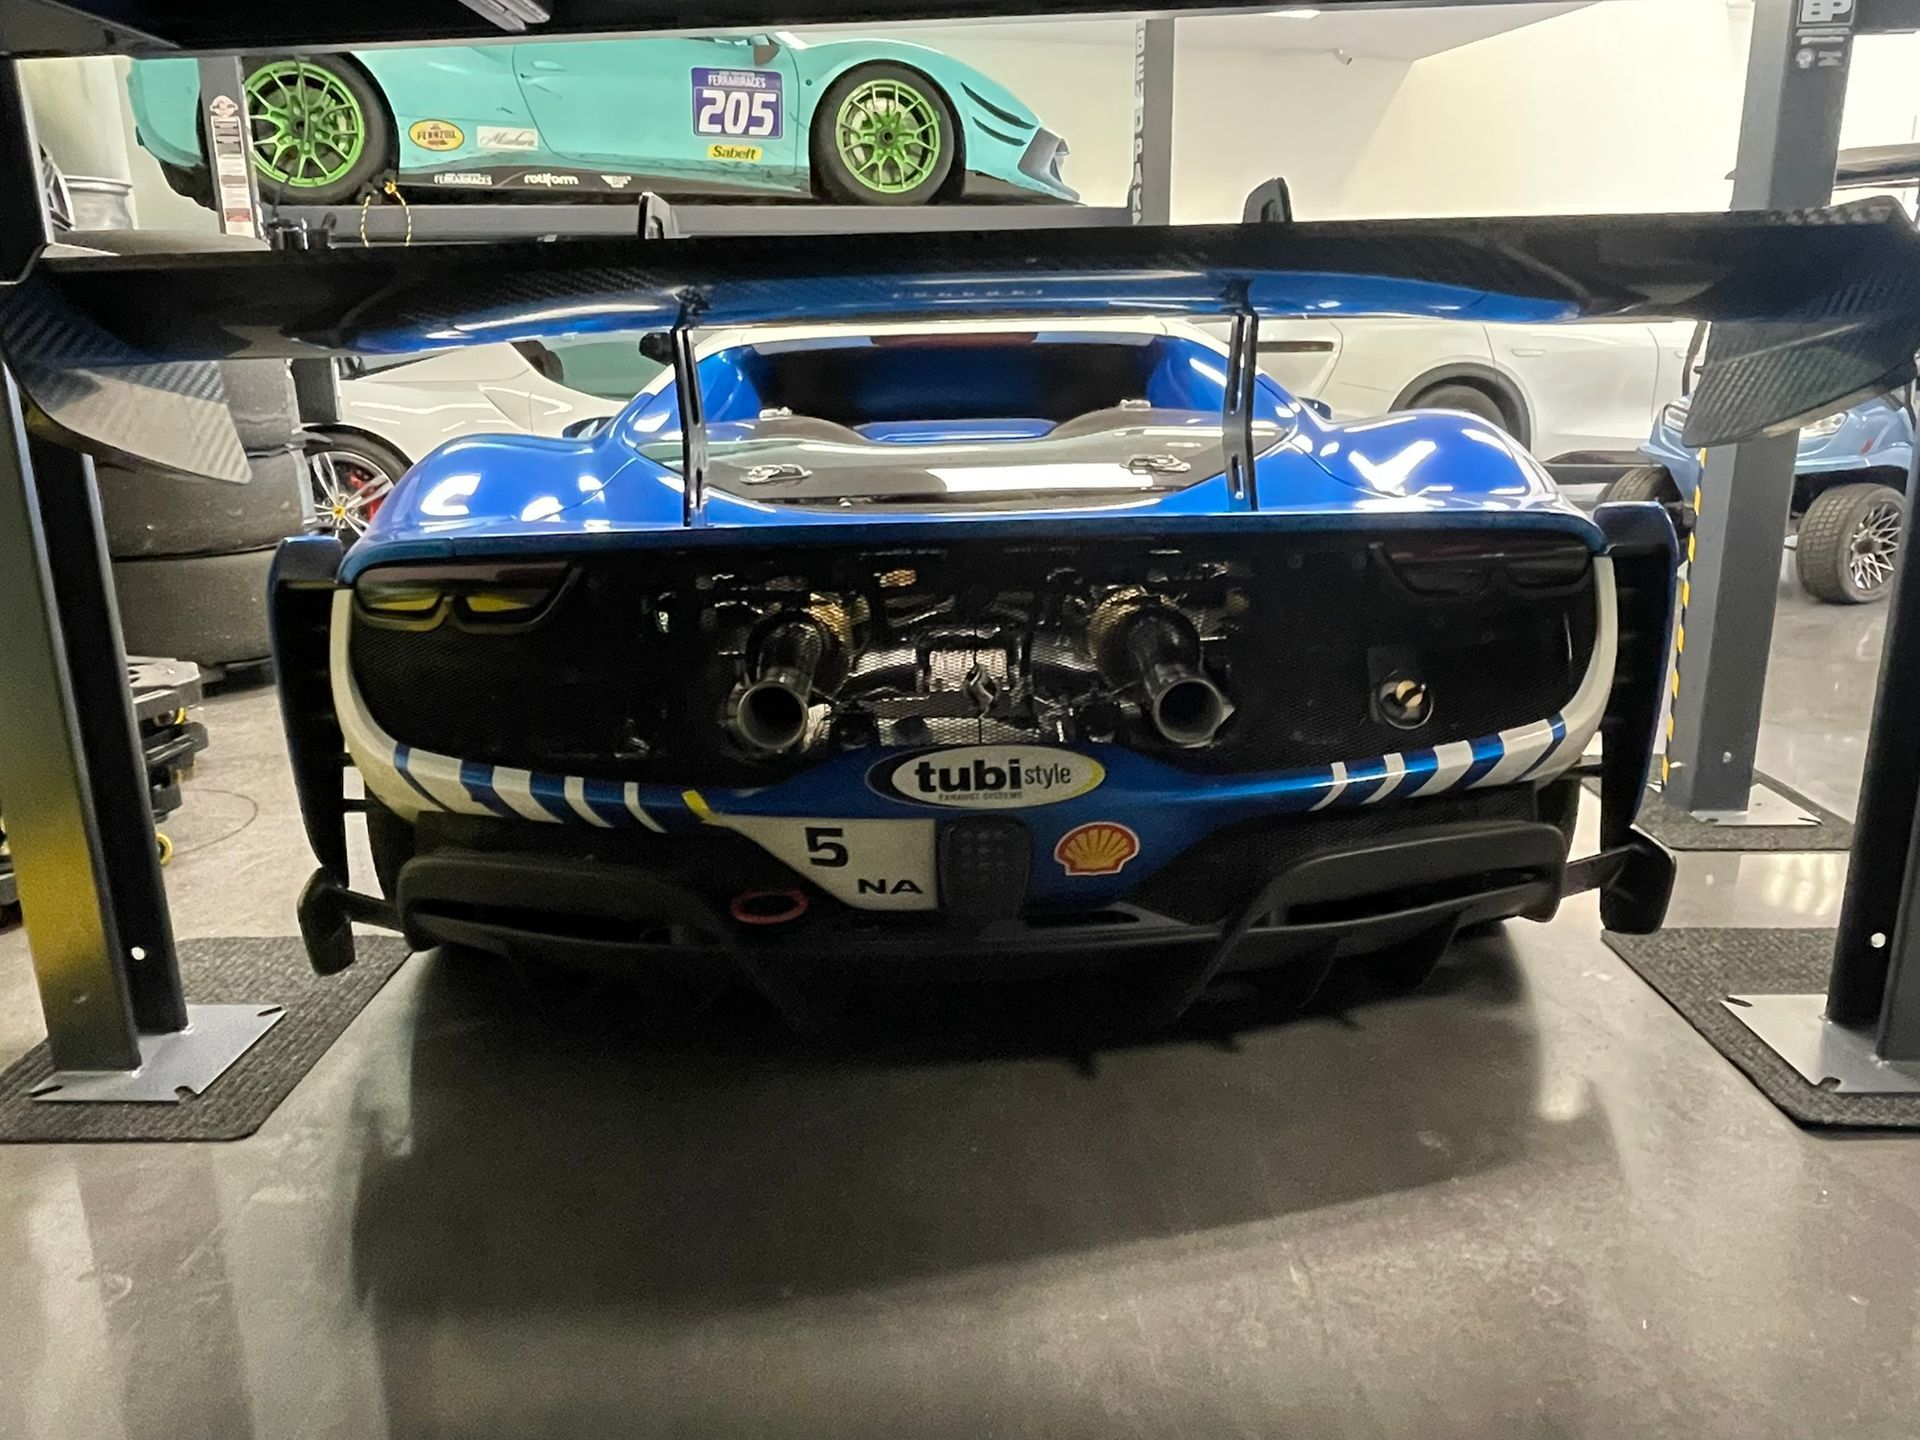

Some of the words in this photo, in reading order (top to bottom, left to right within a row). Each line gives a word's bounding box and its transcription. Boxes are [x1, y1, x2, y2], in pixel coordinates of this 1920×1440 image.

[698, 89, 777, 136] 205
[416, 130, 457, 141] PENNZOIL
[712, 145, 757, 160] Sabelt
[524, 172, 579, 187] rotiform
[914, 758, 1022, 793] tubi
[1023, 763, 1072, 789] style
[804, 827, 849, 868] 5
[857, 878, 924, 895] NA
